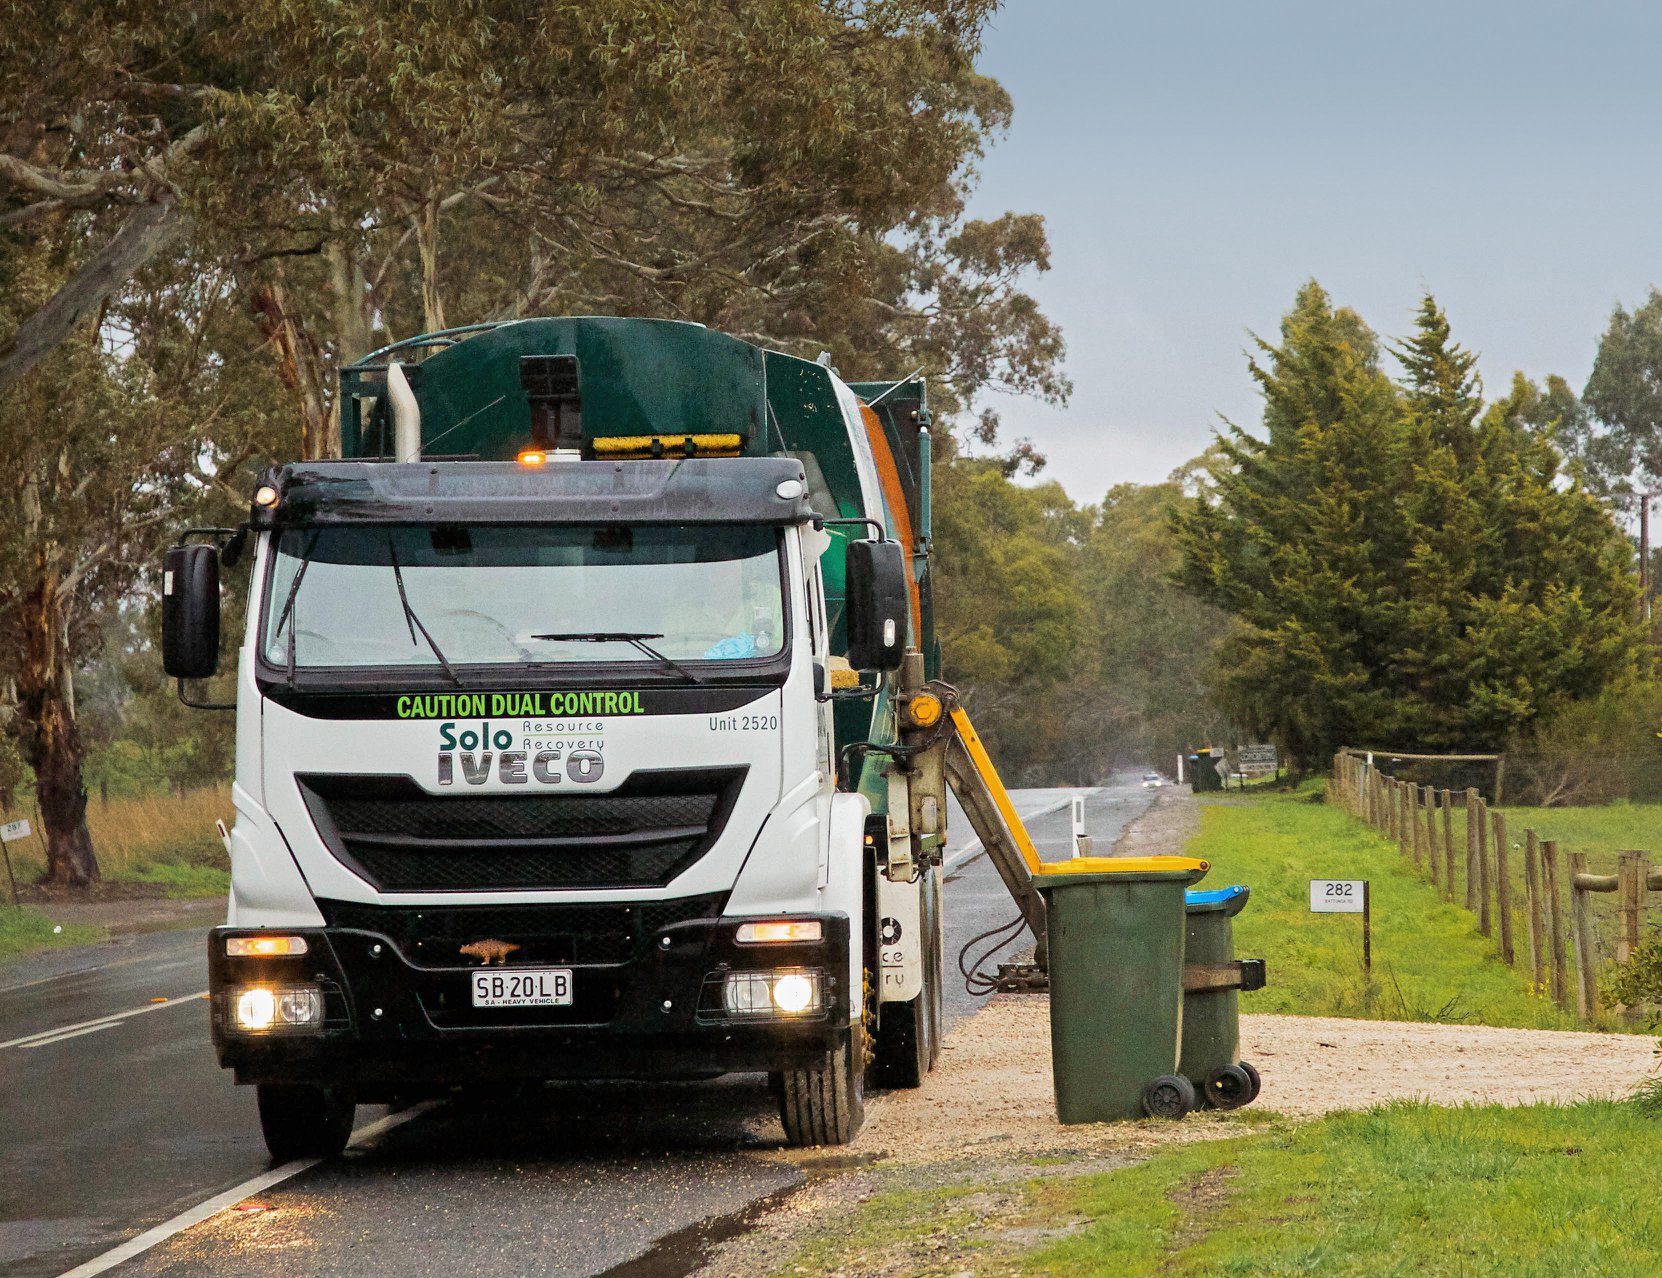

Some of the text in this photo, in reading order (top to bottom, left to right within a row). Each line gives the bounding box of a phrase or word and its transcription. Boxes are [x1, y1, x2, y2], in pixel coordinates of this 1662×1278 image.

[397, 691, 645, 718] CAUTION DUAL CONTROL
[522, 720, 604, 733] Resource
[709, 715, 778, 731] Unit 2520
[439, 721, 514, 752] Solo
[522, 738, 605, 752] Recovery
[437, 749, 606, 786] IVECO
[1325, 883, 1353, 896] 282
